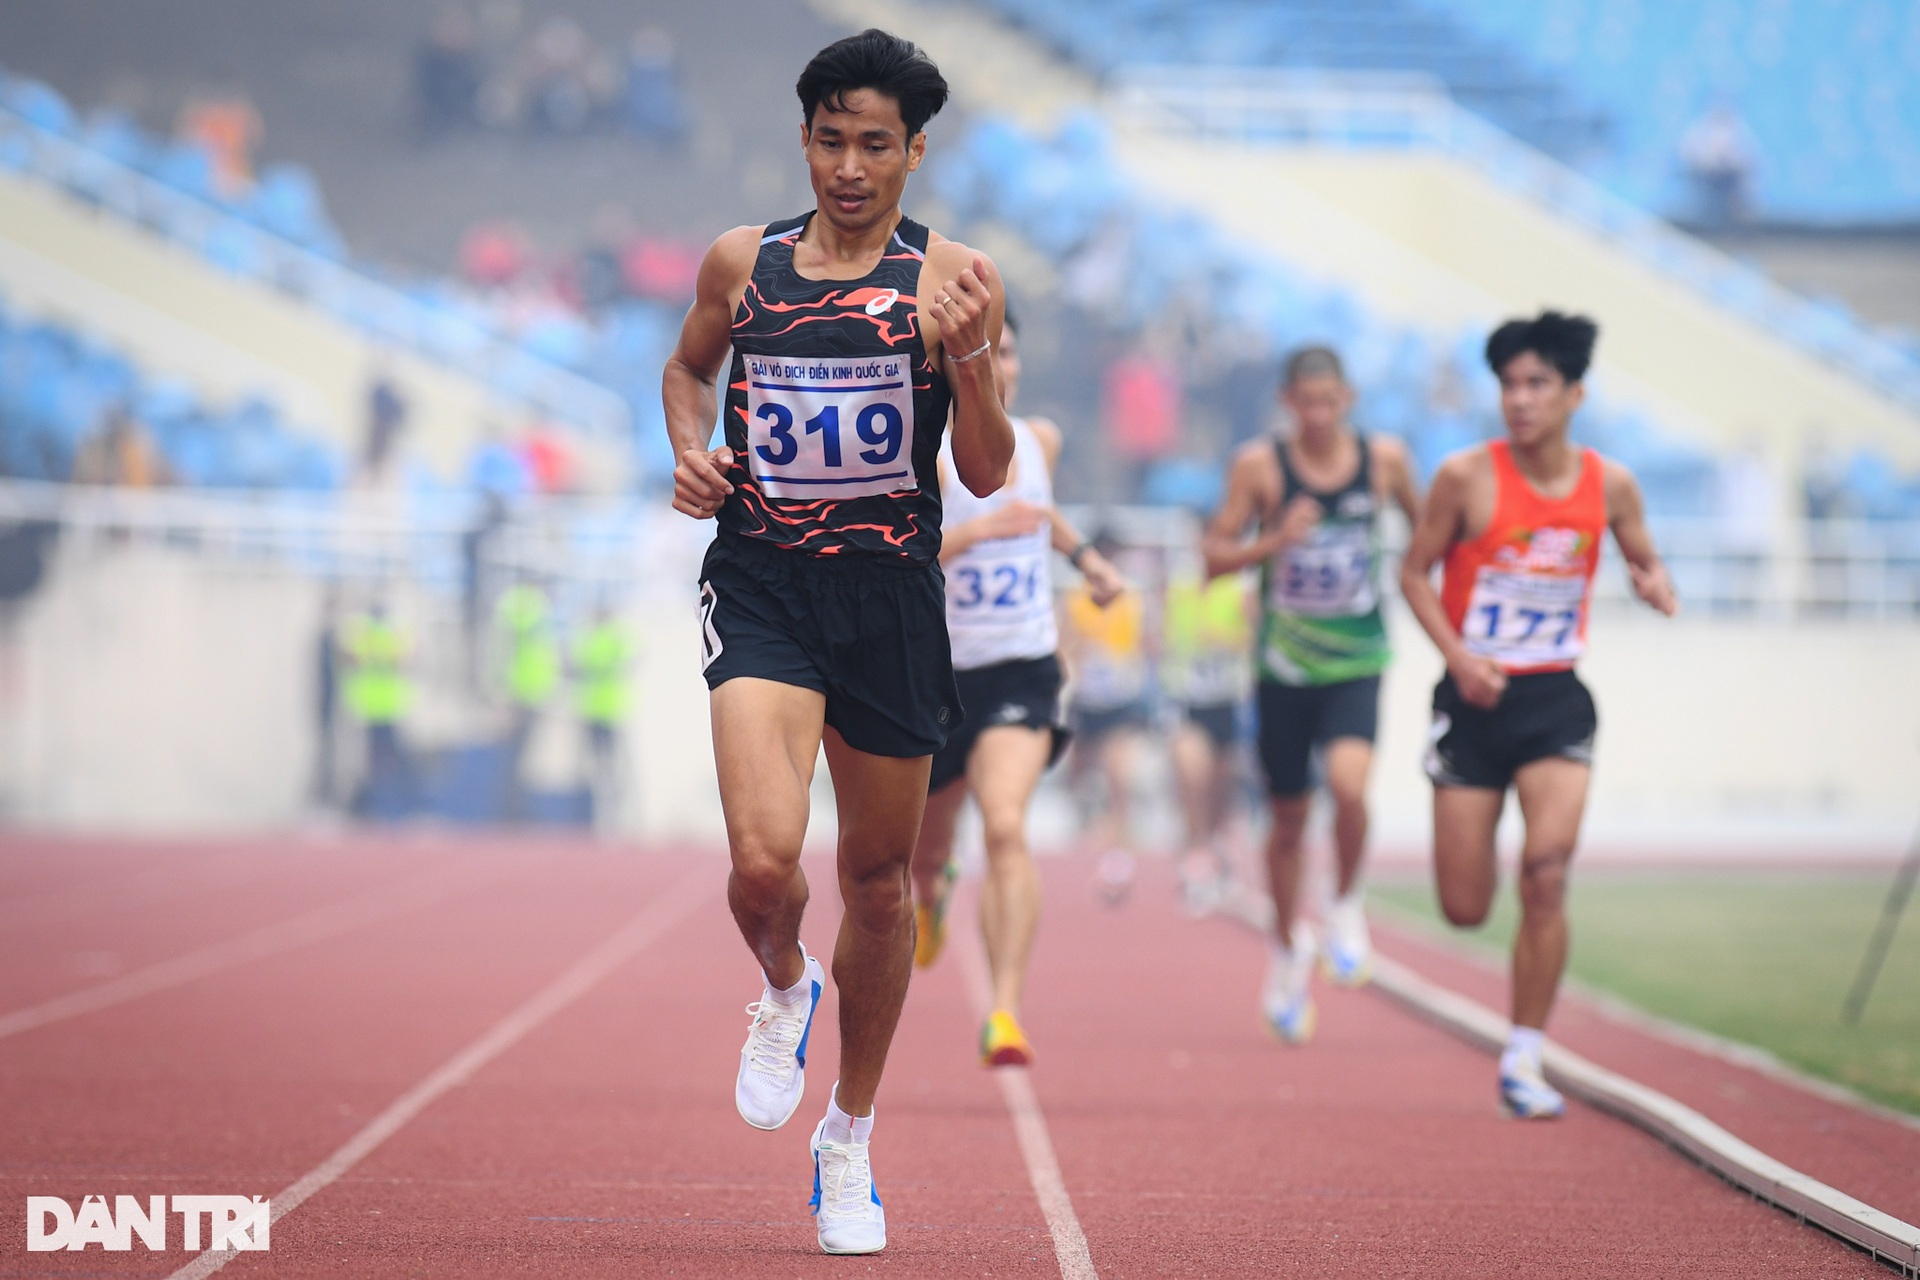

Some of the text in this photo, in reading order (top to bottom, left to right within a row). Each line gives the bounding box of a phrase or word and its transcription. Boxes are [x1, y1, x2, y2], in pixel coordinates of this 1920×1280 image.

[832, 366, 853, 380] KINH
[856, 360, 882, 379] QUỐC
[885, 362, 900, 376] GIA
[755, 402, 904, 468] 319
[1480, 604, 1577, 647] 177
